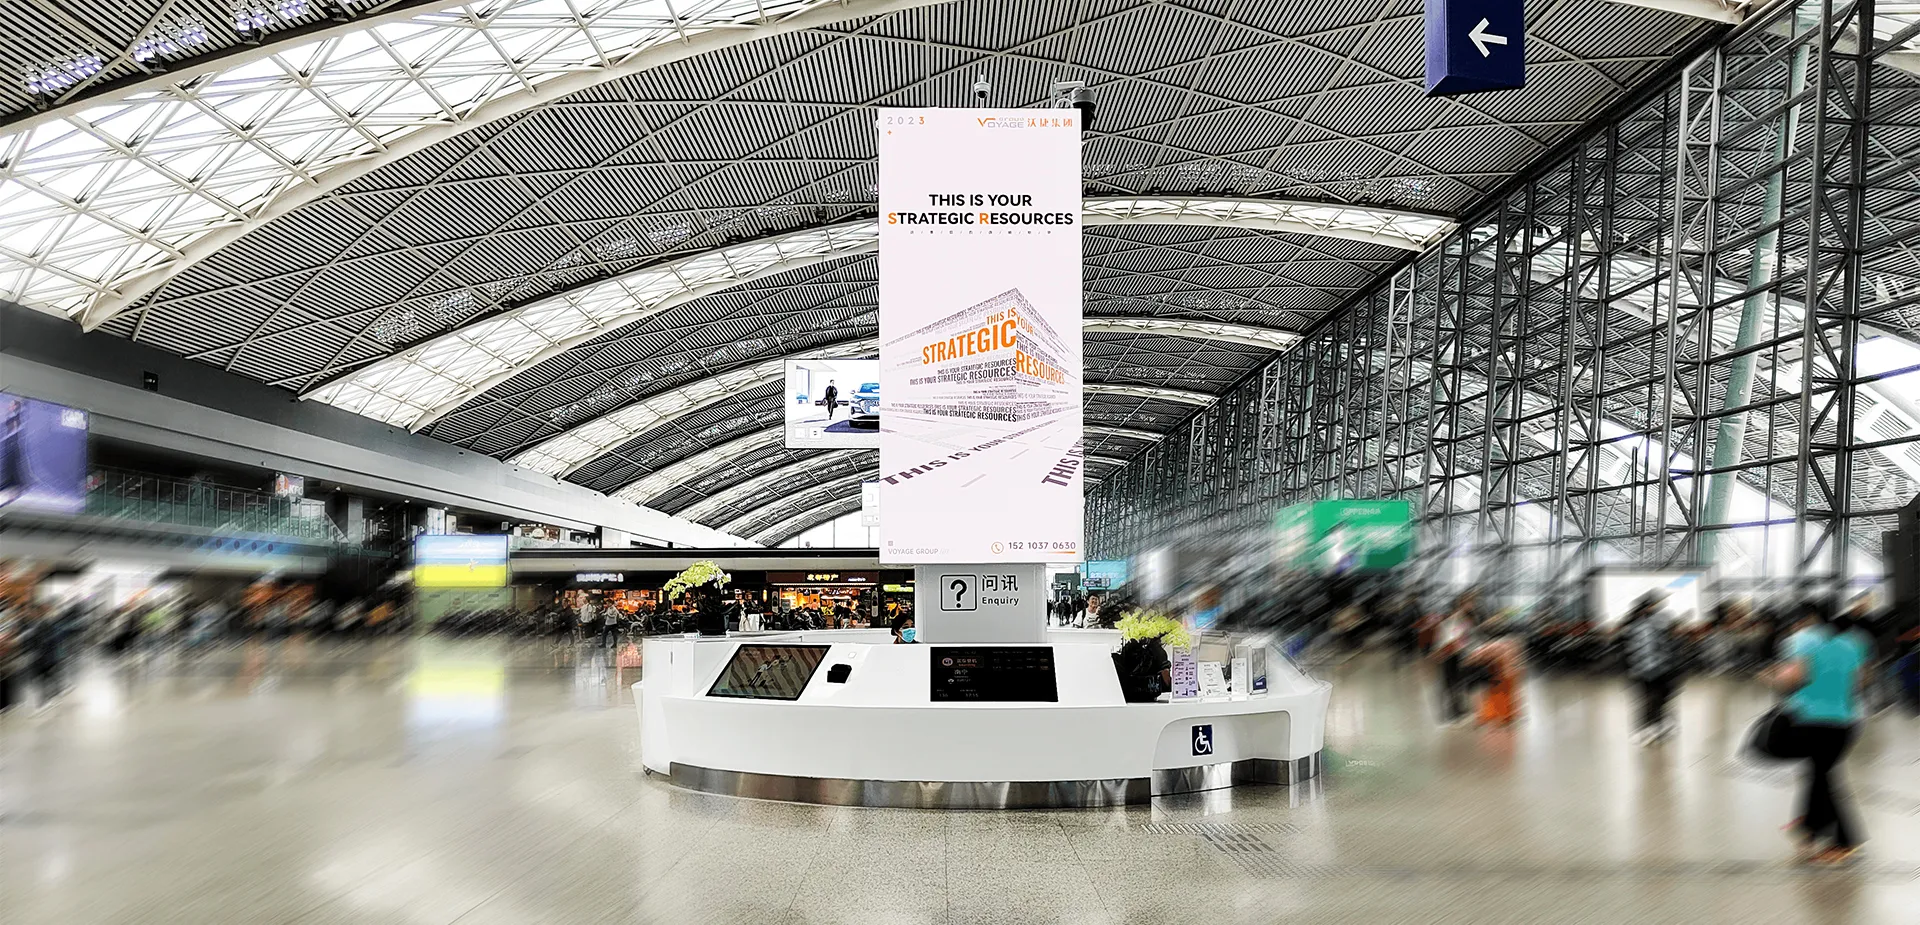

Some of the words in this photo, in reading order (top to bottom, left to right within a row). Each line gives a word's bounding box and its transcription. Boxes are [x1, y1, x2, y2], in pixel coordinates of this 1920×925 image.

[887, 116, 925, 125] 2023
[929, 194, 965, 206] THIS
[970, 194, 984, 206] IS
[988, 194, 1032, 206] YOUR
[888, 212, 974, 225] STRATEGIC
[979, 212, 1074, 225] RESOURCES
[986, 311, 1005, 325] THIS
[1007, 307, 1017, 318] IS
[1016, 314, 1034, 336] YOUR
[923, 319, 1017, 364] STRATEGIC
[1016, 340, 1029, 356] THIS
[961, 362, 983, 372] STRATEGIC
[984, 358, 1016, 368] RESOURCES
[1016, 349, 1065, 385] RESOURCES
[924, 376, 936, 384] YOUR
[938, 372, 968, 383] STRATEGIC
[969, 366, 1017, 380] RESOURCES
[949, 410, 976, 419] STRATEGIC
[977, 412, 1017, 422] RESOURCES
[983, 406, 1016, 414] RESOURCES
[880, 459, 948, 486] THIS
[948, 452, 970, 460] IS
[968, 439, 1004, 452] YOUR
[1041, 458, 1080, 487] THIS
[1066, 448, 1084, 458] IS
[1008, 542, 1024, 550] 152
[1028, 542, 1048, 550] 1037
[1052, 542, 1076, 550] 0630
[982, 574, 1018, 592] 问讯
[982, 596, 1019, 606] Enquiry
